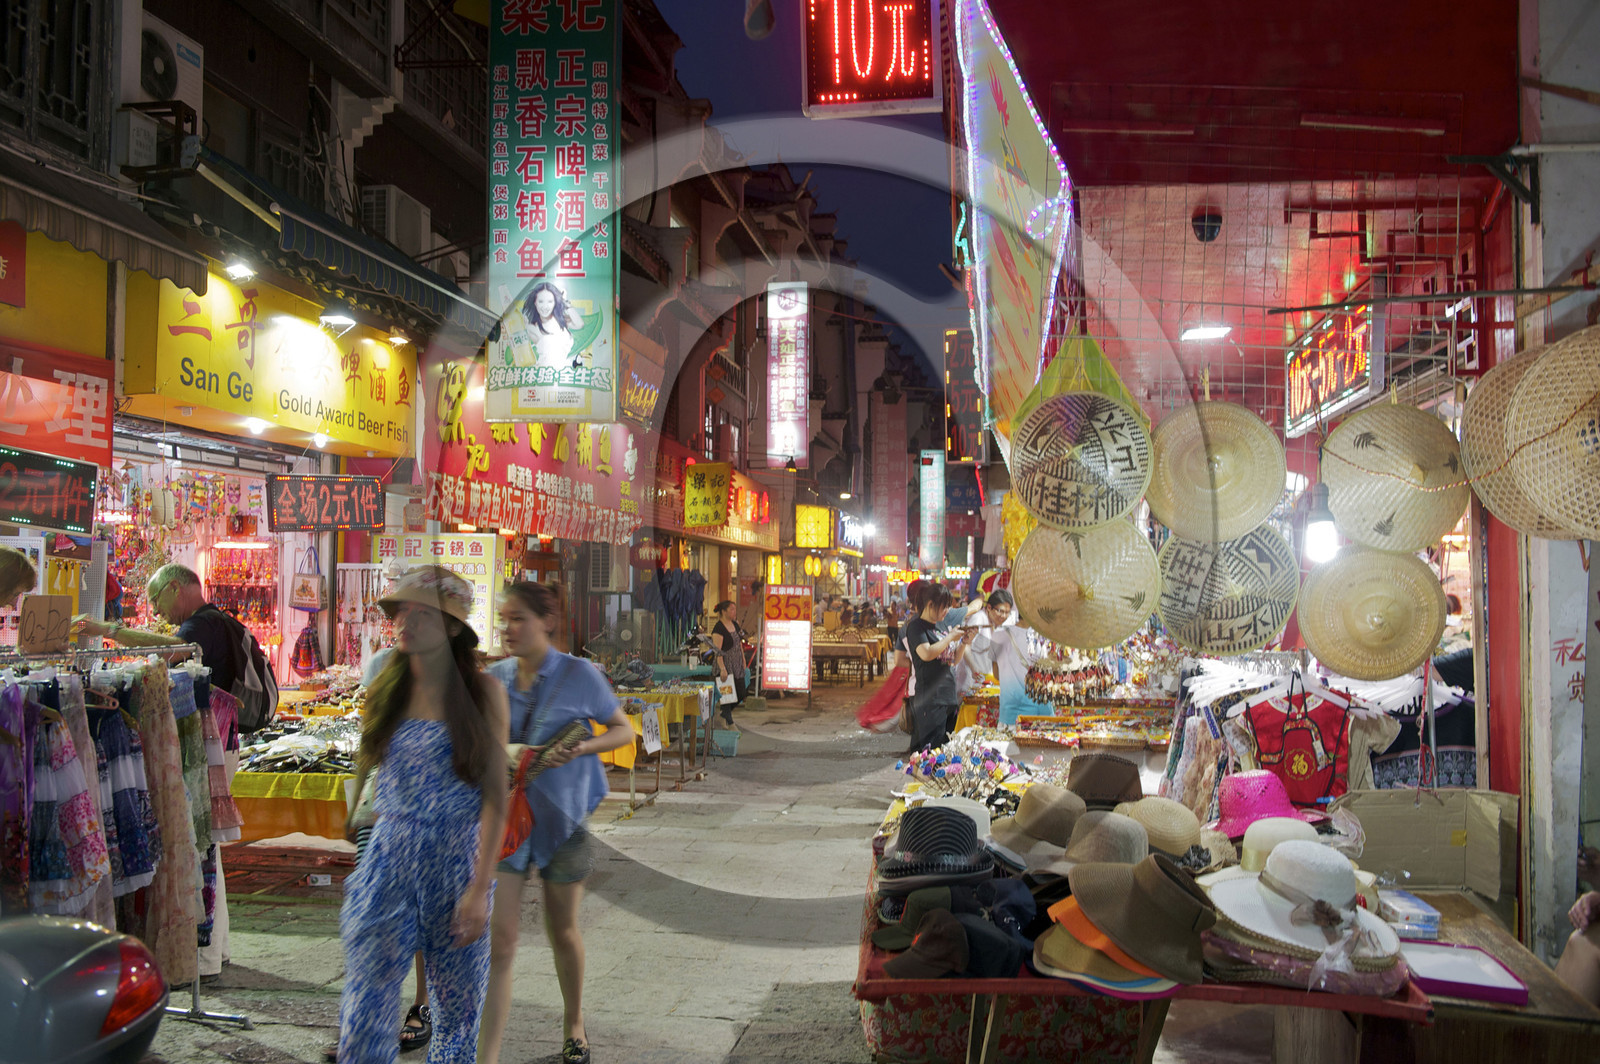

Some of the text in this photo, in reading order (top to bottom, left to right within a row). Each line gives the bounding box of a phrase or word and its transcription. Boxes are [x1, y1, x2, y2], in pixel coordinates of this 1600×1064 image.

[493, 65, 509, 264] 漓江野生鱼虾 煲粥 面食
[515, 49, 548, 278] 飘香石锅鱼
[554, 49, 587, 278] 正宗啤酒鱼
[592, 61, 608, 258] 阳朔特色菜 干锅 火锅
[180, 357, 253, 402] San Ge
[280, 389, 409, 443] Gold Award Beer Fish
[952, 424, 977, 457] 10元
[277, 482, 378, 525] 全场2元1件
[378, 538, 484, 557] 梁記 石锅鱼
[437, 563, 487, 575] 宗啤酒鱼
[765, 595, 801, 620] 35
